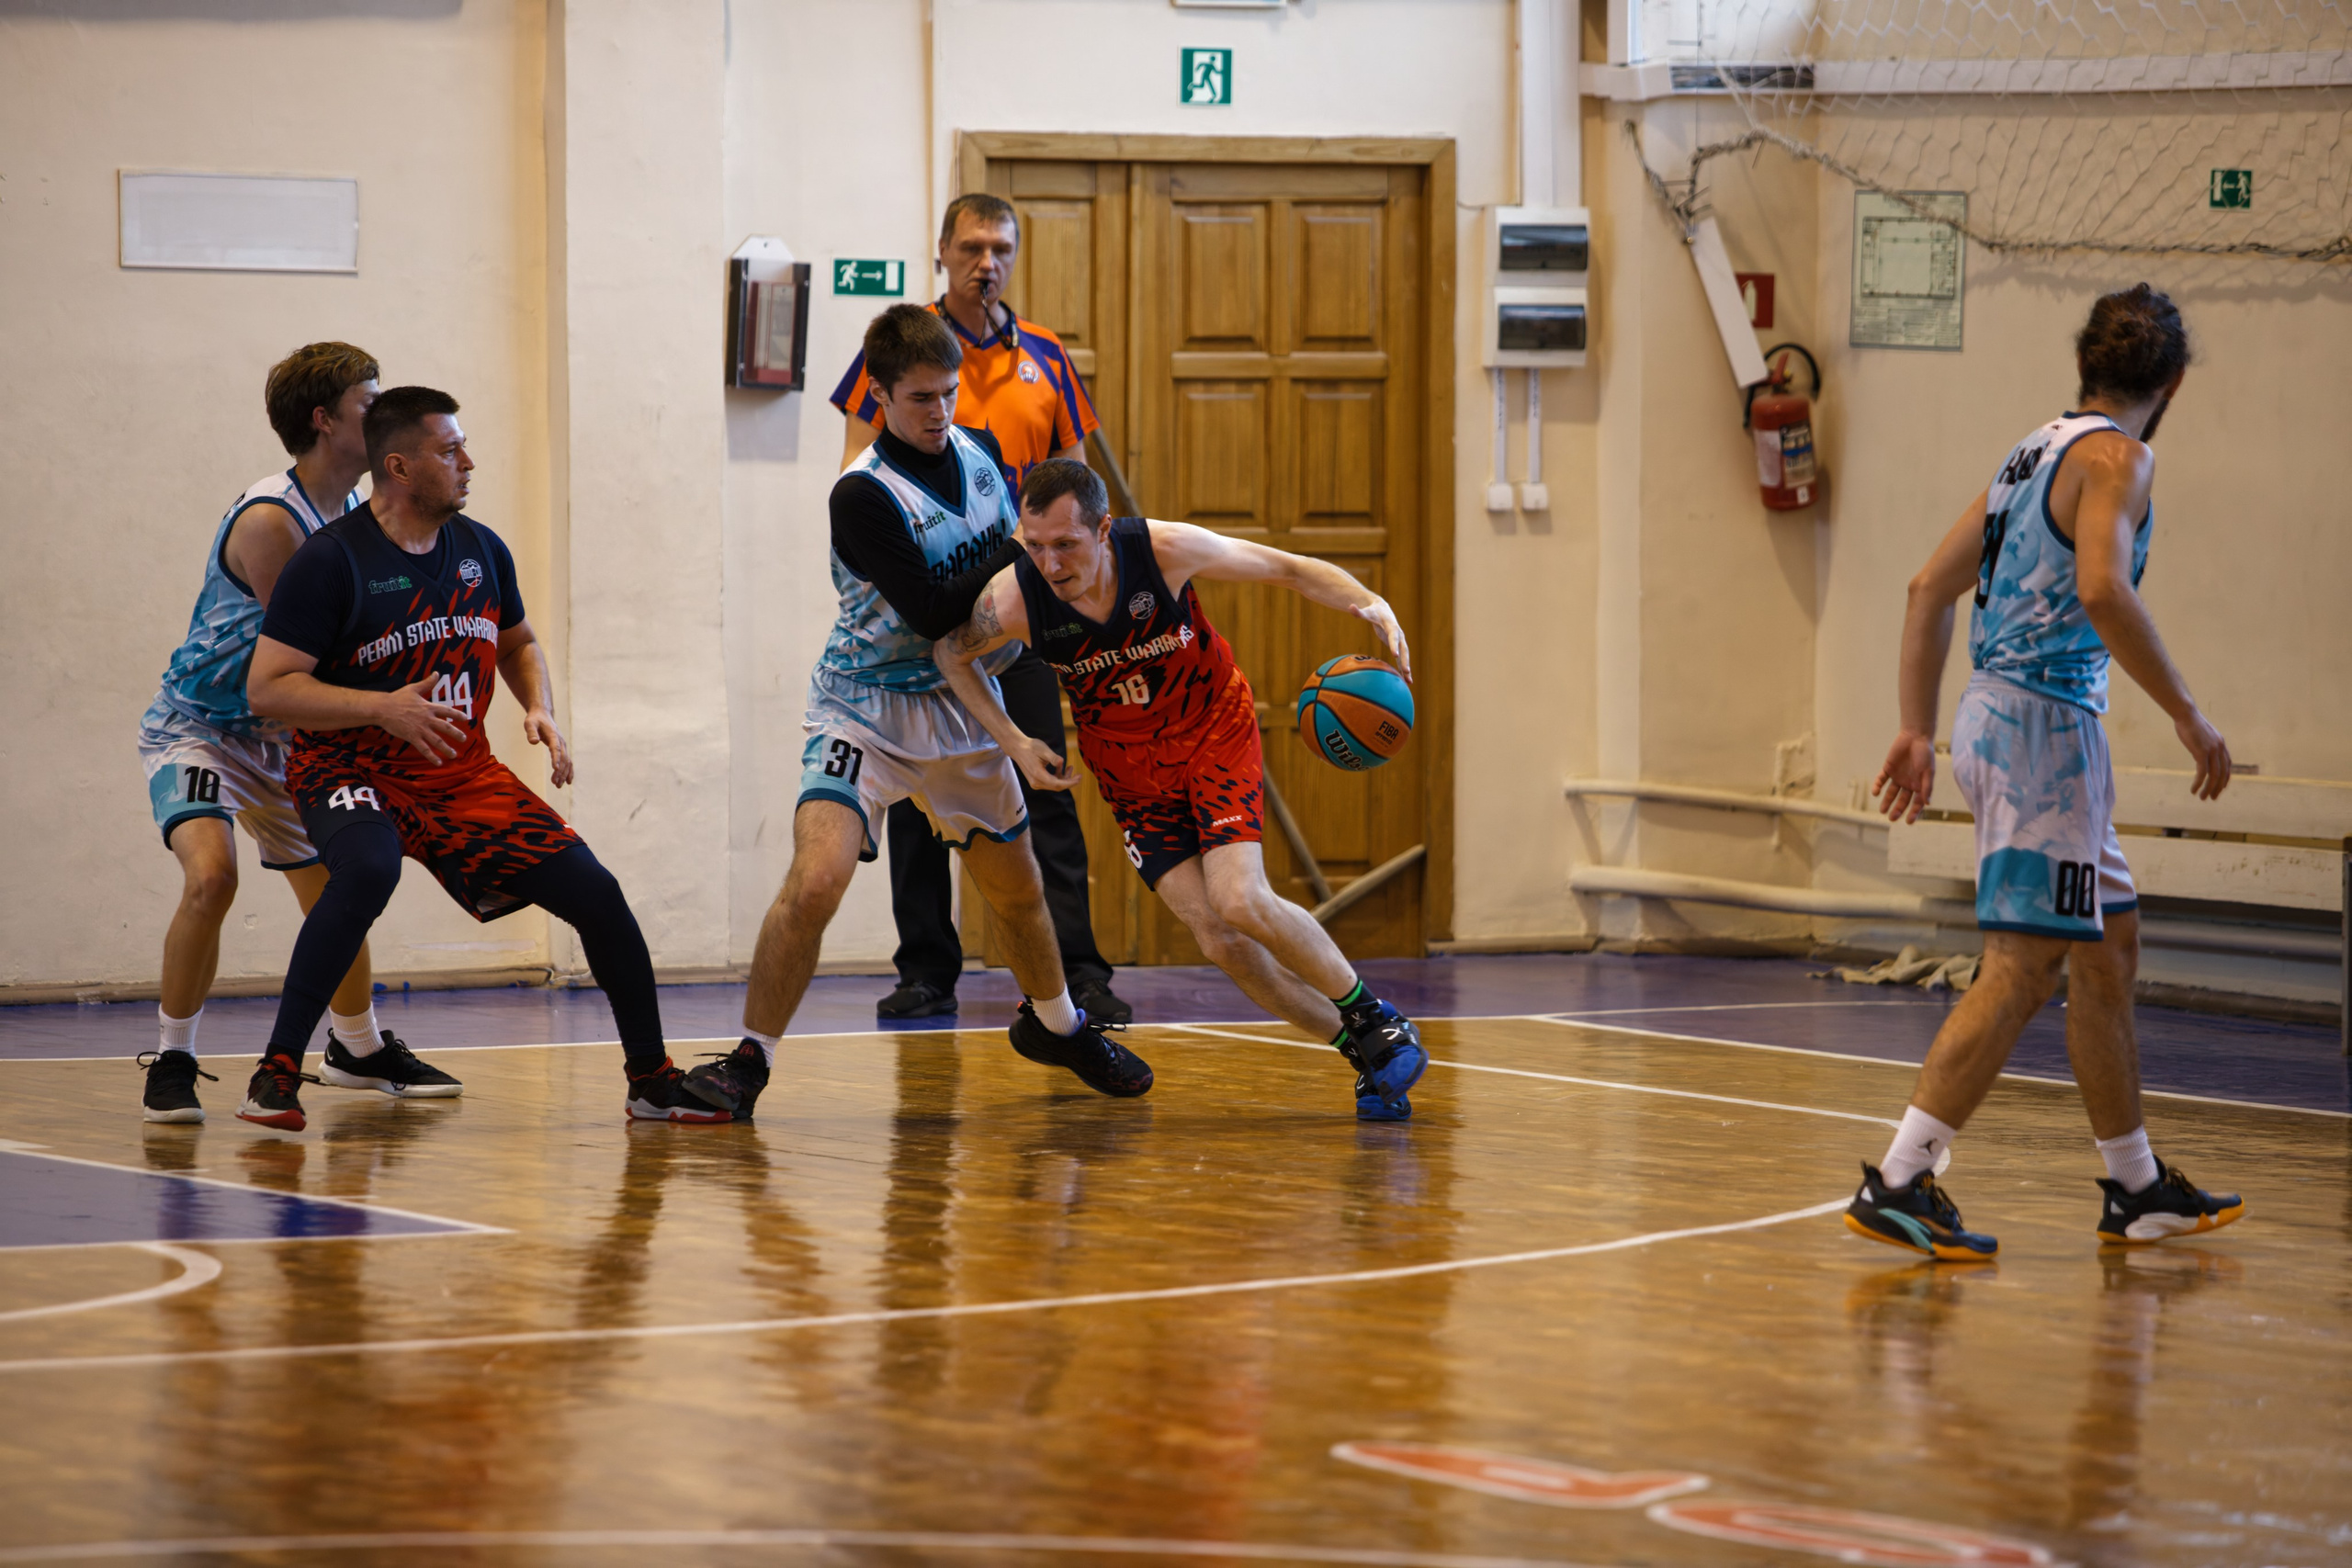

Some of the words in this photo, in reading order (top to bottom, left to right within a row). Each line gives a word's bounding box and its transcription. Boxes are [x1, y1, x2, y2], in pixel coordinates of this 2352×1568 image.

[368, 575, 413, 594] fruitit
[357, 631, 403, 667] PERM
[406, 616, 450, 647] STATE
[1074, 650, 1124, 675] STATE
[432, 671, 473, 723] 44
[1112, 674, 1150, 705] 16
[1378, 720, 1399, 740] FIBA
[824, 739, 864, 786] 31
[1324, 728, 1371, 772] Wils
[185, 766, 220, 804] 10
[328, 785, 381, 811] 44
[1213, 815, 1242, 828] MAXX
[2055, 860, 2096, 918] 00
